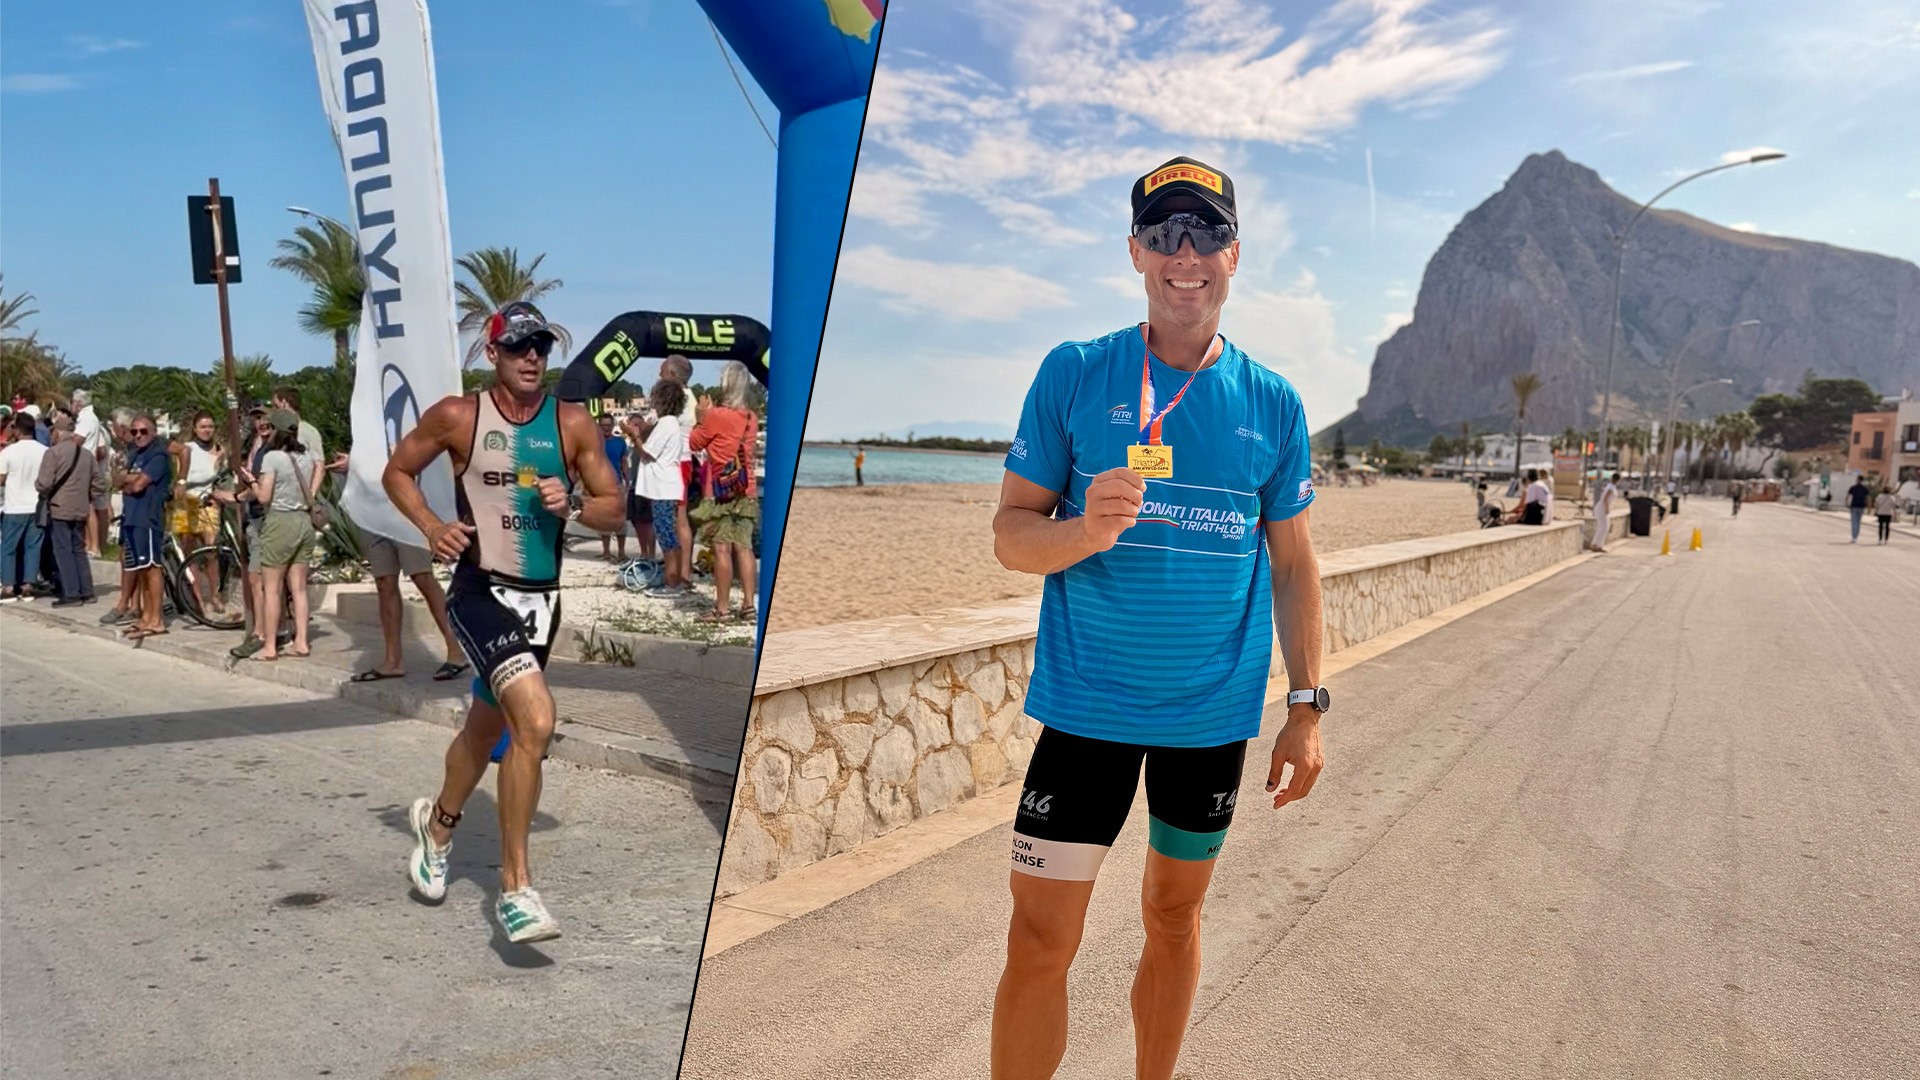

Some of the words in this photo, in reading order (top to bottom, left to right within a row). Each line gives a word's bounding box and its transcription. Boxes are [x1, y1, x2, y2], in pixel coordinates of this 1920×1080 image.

[1150, 167, 1216, 188] PIRELLI
[1112, 410, 1133, 419] FITRI
[1132, 458, 1170, 467] Triathlon
[1181, 520, 1246, 535] TRIATHLON
